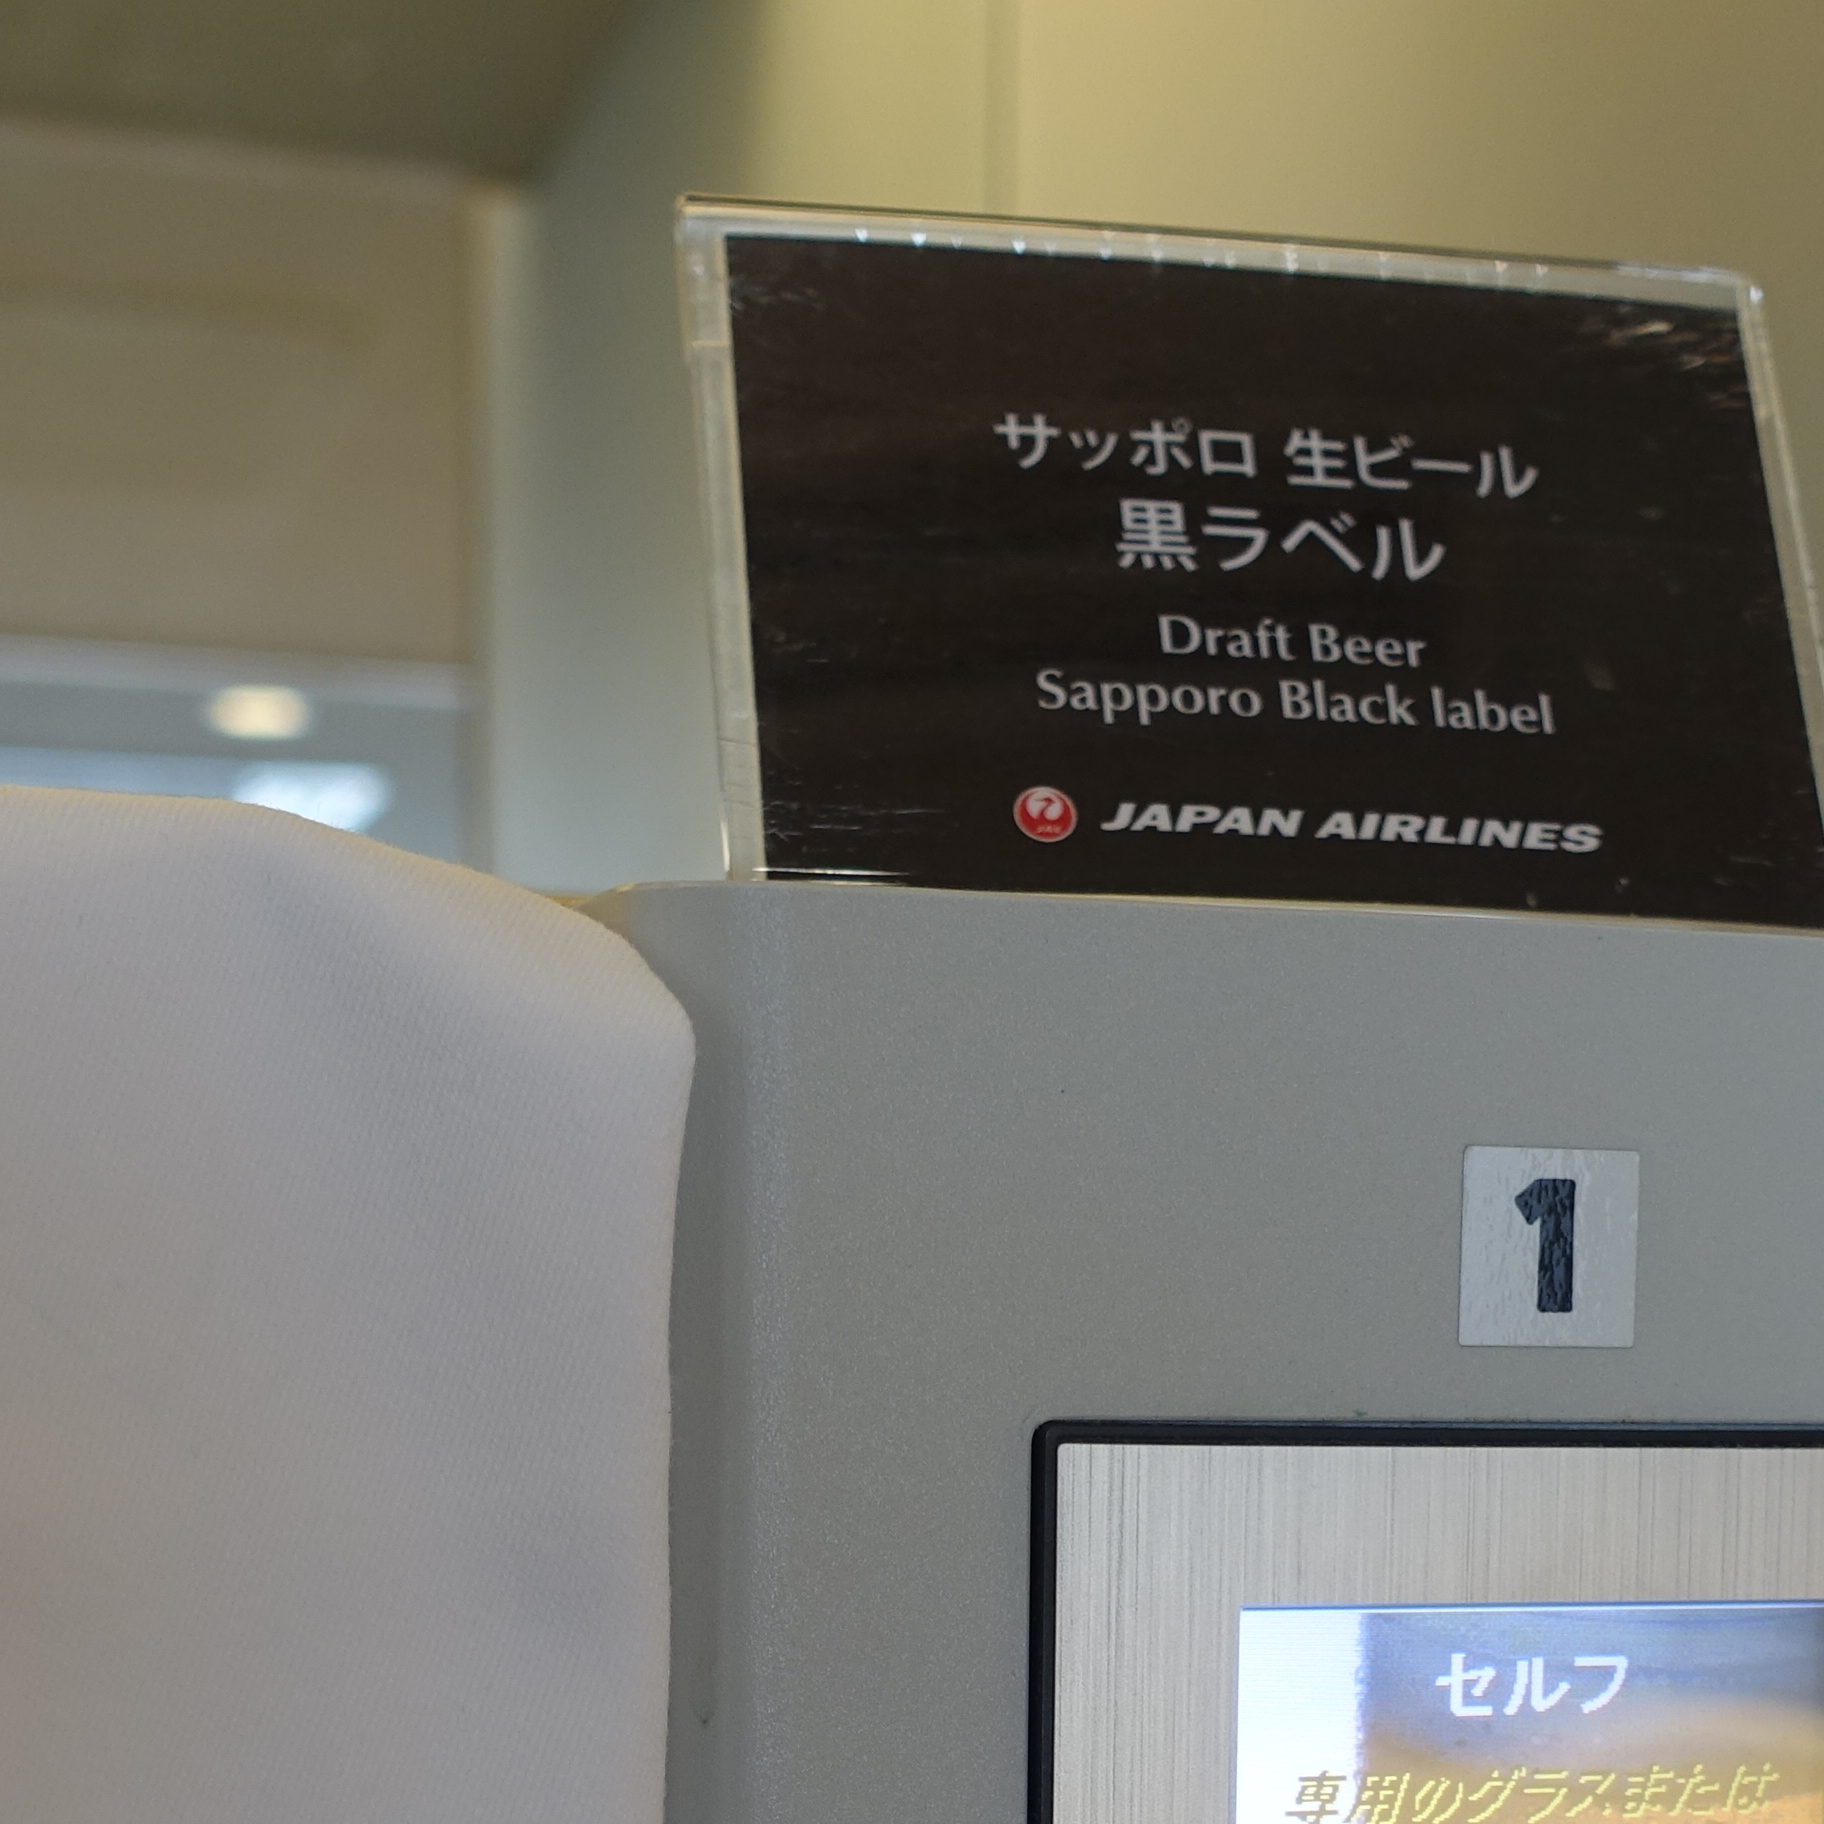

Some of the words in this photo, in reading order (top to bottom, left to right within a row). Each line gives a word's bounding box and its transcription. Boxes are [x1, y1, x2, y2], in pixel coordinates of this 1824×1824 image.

[993, 412, 1258, 478] サッポロ
[1283, 427, 1539, 499] 生ビール
[1116, 498, 1446, 581] 黒ラベル
[1157, 613, 1295, 662] Draft
[1309, 622, 1427, 668] Beer
[1035, 668, 1263, 726] Sapporo
[1279, 679, 1418, 726] Black
[1430, 686, 1556, 734] label
[1101, 803, 1303, 840] JAPAN
[1316, 812, 1604, 854] AIRLINES
[1514, 1178, 1576, 1313] 1
[1436, 1653, 1628, 1717] セルフ
